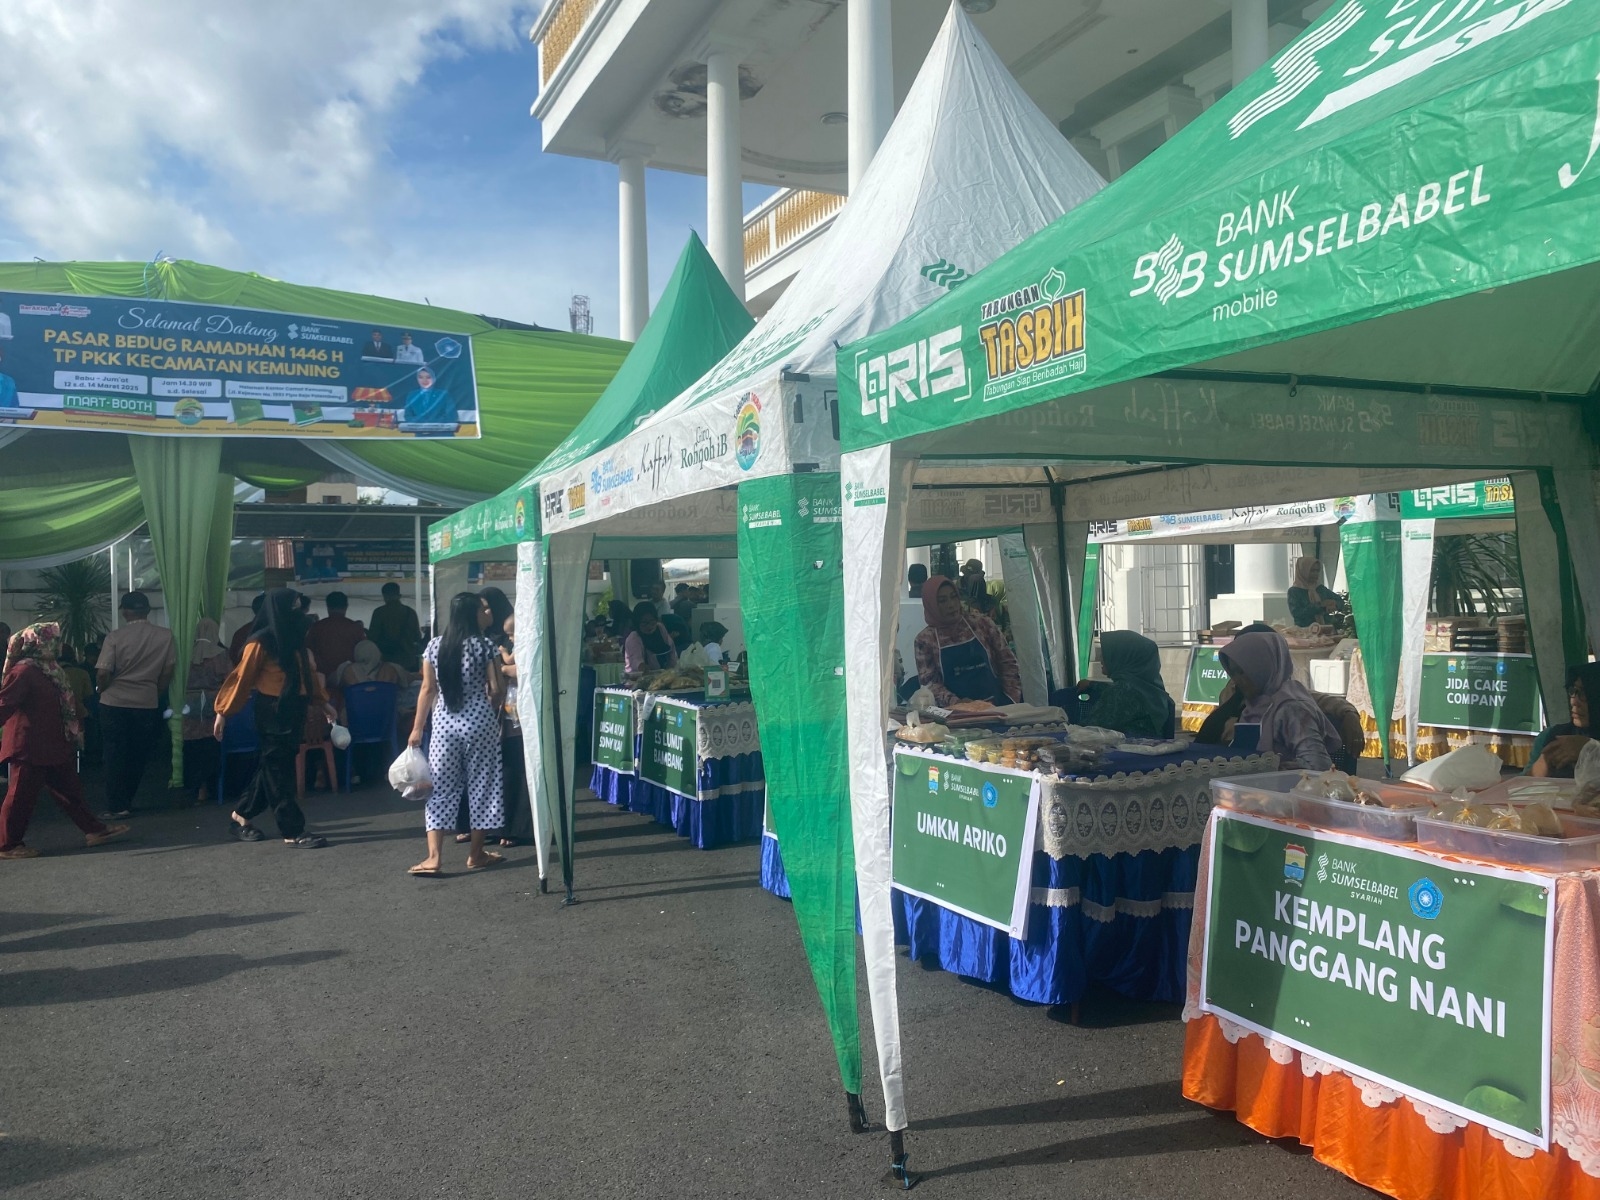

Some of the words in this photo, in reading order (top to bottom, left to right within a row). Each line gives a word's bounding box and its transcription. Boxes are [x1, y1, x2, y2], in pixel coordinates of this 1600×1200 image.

[1213, 165, 1491, 288] SUMSELBABEL
[1216, 185, 1300, 247] BANK
[981, 284, 1040, 320] TABUNGAN
[1212, 288, 1278, 322] mobile
[118, 307, 201, 331] Selamat
[205, 314, 279, 343] Datang
[301, 325, 321, 334] BANK
[301, 333, 354, 344] SUMSELBABEL
[979, 289, 1086, 381] TASBIH
[44, 329, 109, 348] PASAR
[115, 334, 177, 352] BEDUG
[181, 338, 285, 358] RAMADHAN
[289, 343, 328, 362] 1446
[332, 350, 343, 363] H
[53, 348, 77, 364] TP
[82, 350, 121, 367] PKK
[126, 354, 242, 374] KECAMATAN
[247, 360, 340, 379] KEMUNING
[859, 325, 967, 425] QRIS
[986, 380, 1015, 396] Tabungan
[1017, 375, 1031, 387] Siap
[1033, 364, 1068, 382] Beribadah
[1069, 357, 1083, 371] Haji
[680, 436, 716, 471] Rofiqoh
[717, 433, 728, 458] iB
[813, 498, 833, 507] BANK
[854, 487, 886, 499] SUMSELBABEL
[1413, 481, 1476, 511] QRIS
[1177, 513, 1223, 525] SUMSELBABEL
[1276, 503, 1314, 518] Rofiqoh
[1315, 502, 1327, 513] iB
[1202, 668, 1228, 679] HELYA
[1445, 677, 1470, 691] JIDA
[1474, 678, 1508, 692] CAKE
[1446, 692, 1507, 707] COMPANY
[655, 729, 662, 744] ES
[663, 731, 684, 752] LUMUT
[653, 748, 684, 772] BAMBANG
[917, 811, 959, 844] UMKM
[963, 824, 1007, 858] ARIKO
[1331, 858, 1357, 875] BANK
[1331, 872, 1399, 899] SUMSELBABEL
[1350, 891, 1383, 906] SYARIAH
[1274, 890, 1446, 971] KEMPLANG
[1234, 919, 1398, 1003] PANGGANG
[1409, 976, 1506, 1039] NANI
